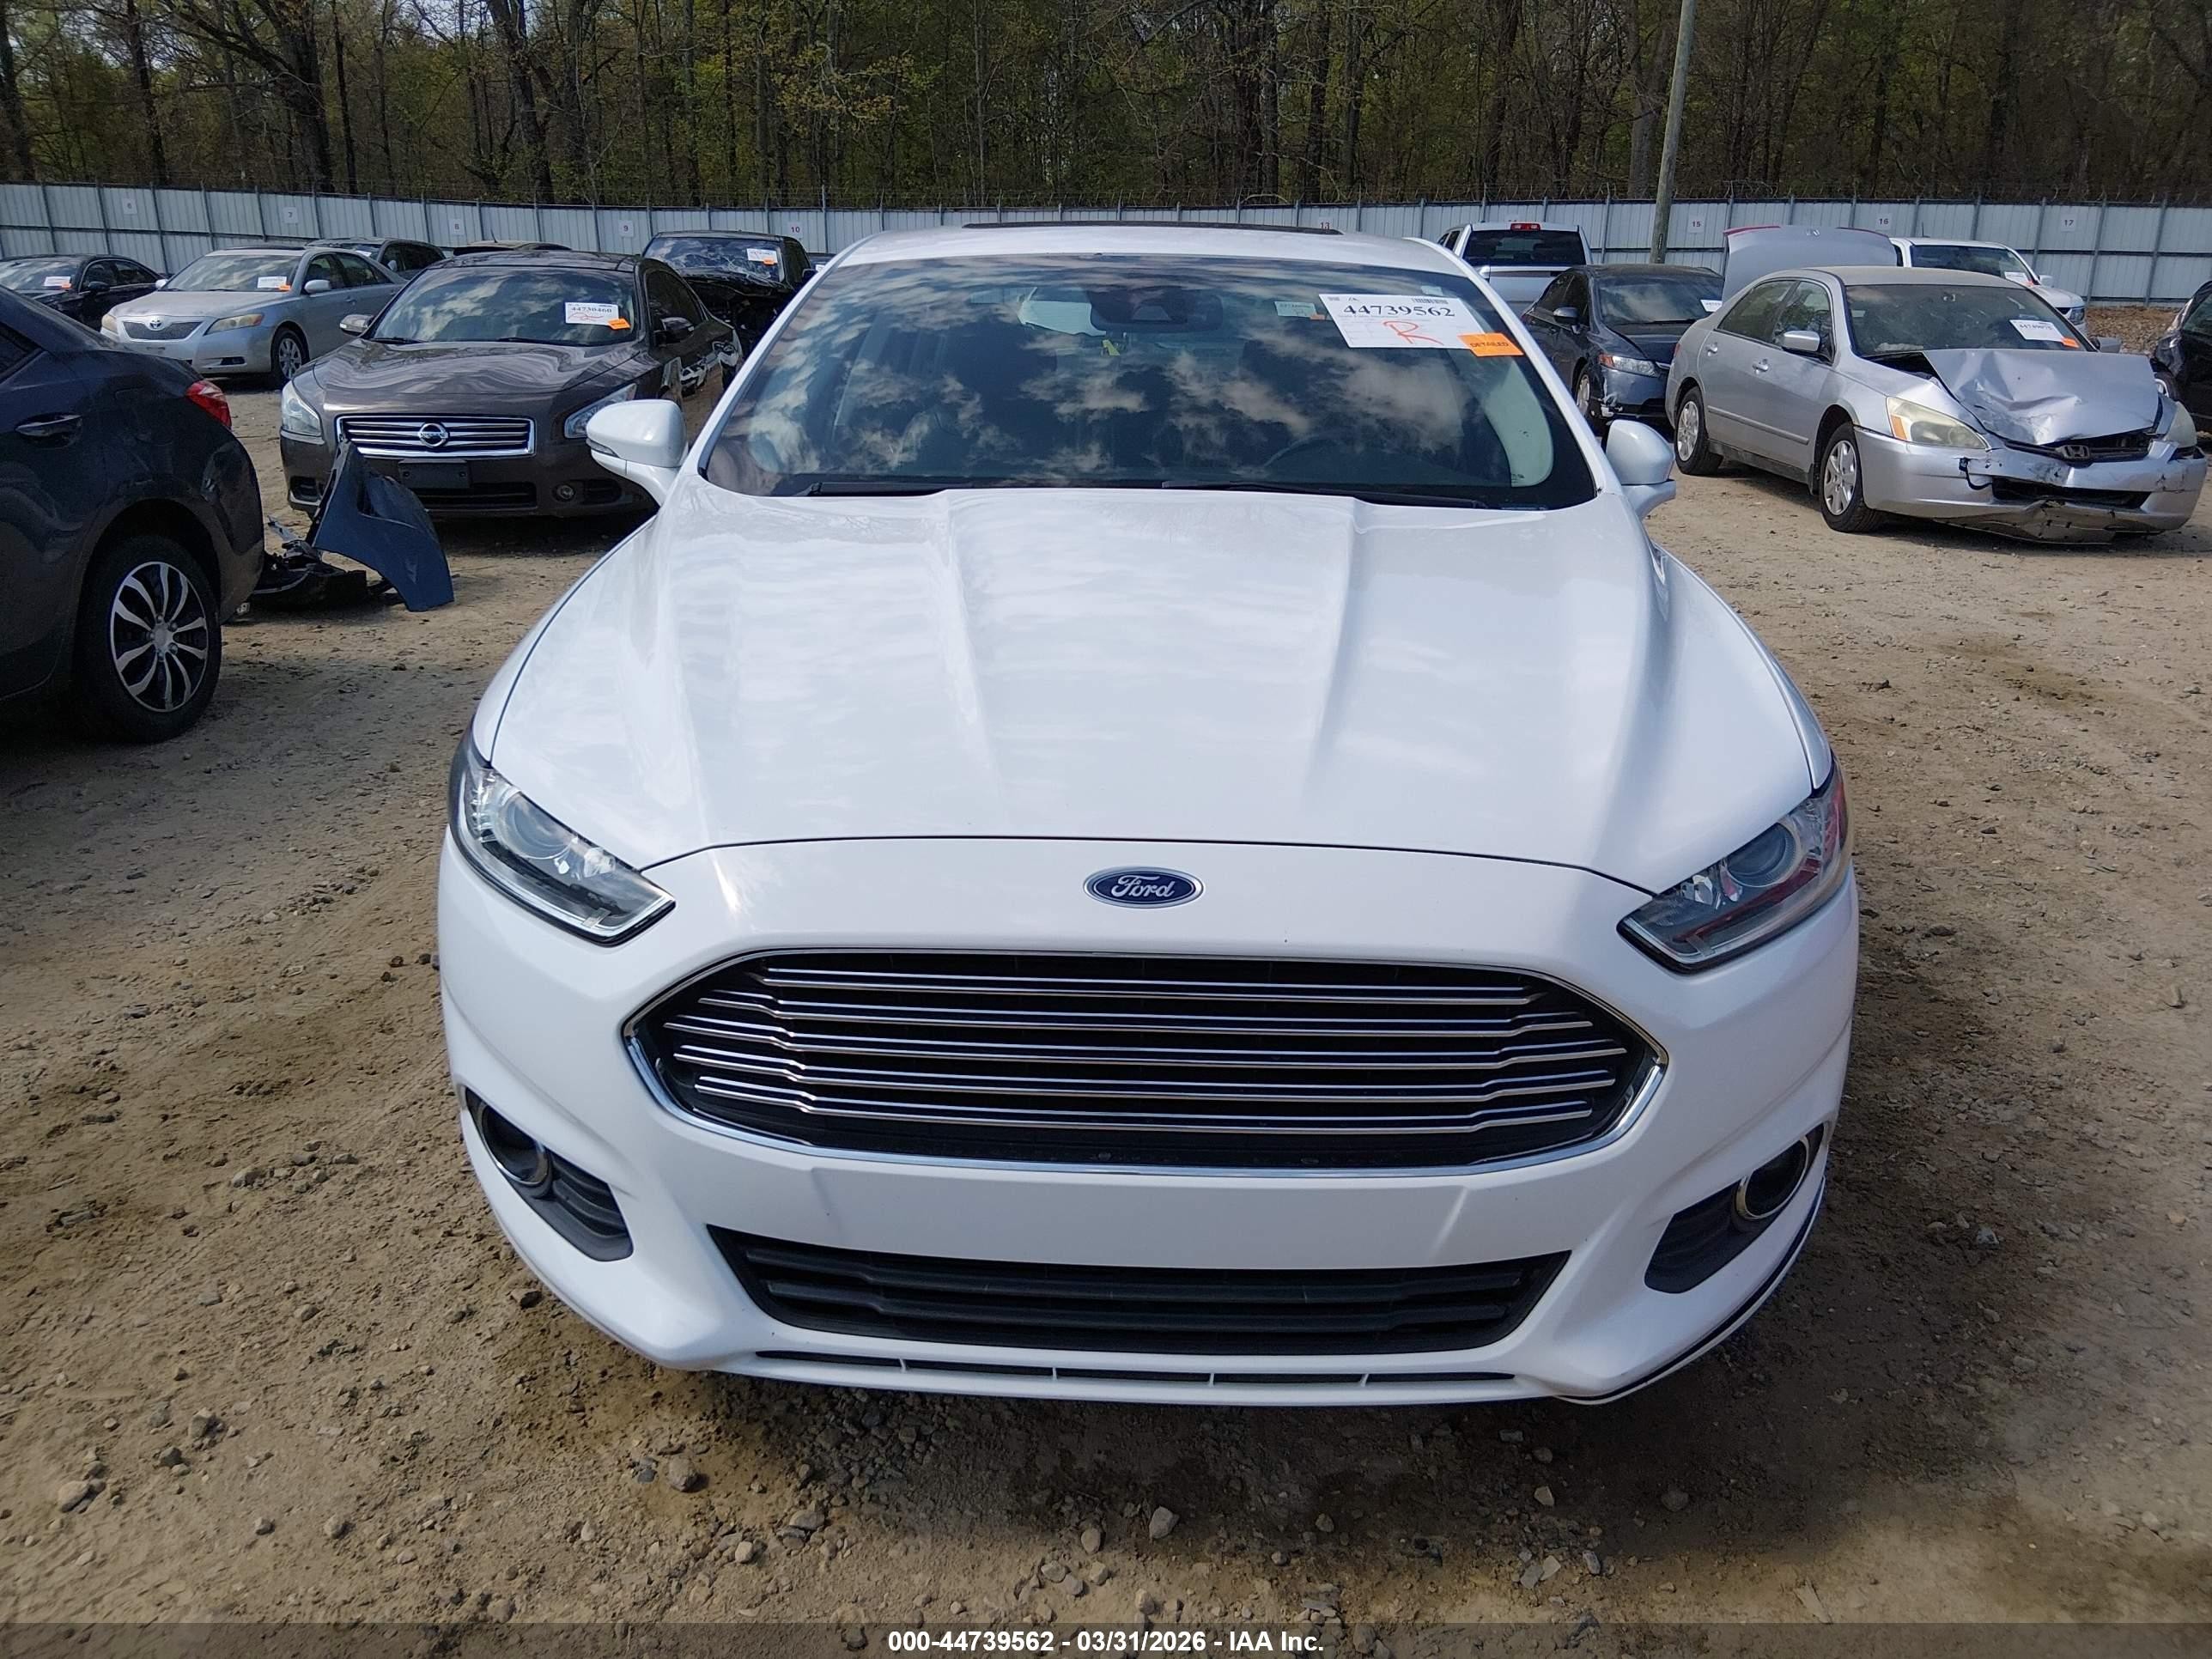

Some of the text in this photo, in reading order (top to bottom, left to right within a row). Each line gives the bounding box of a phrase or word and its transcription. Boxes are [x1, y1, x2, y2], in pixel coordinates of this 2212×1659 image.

[1343, 305, 1455, 317] 44739562
[1382, 320, 1444, 345] R
[1111, 874, 1176, 896] Ford
